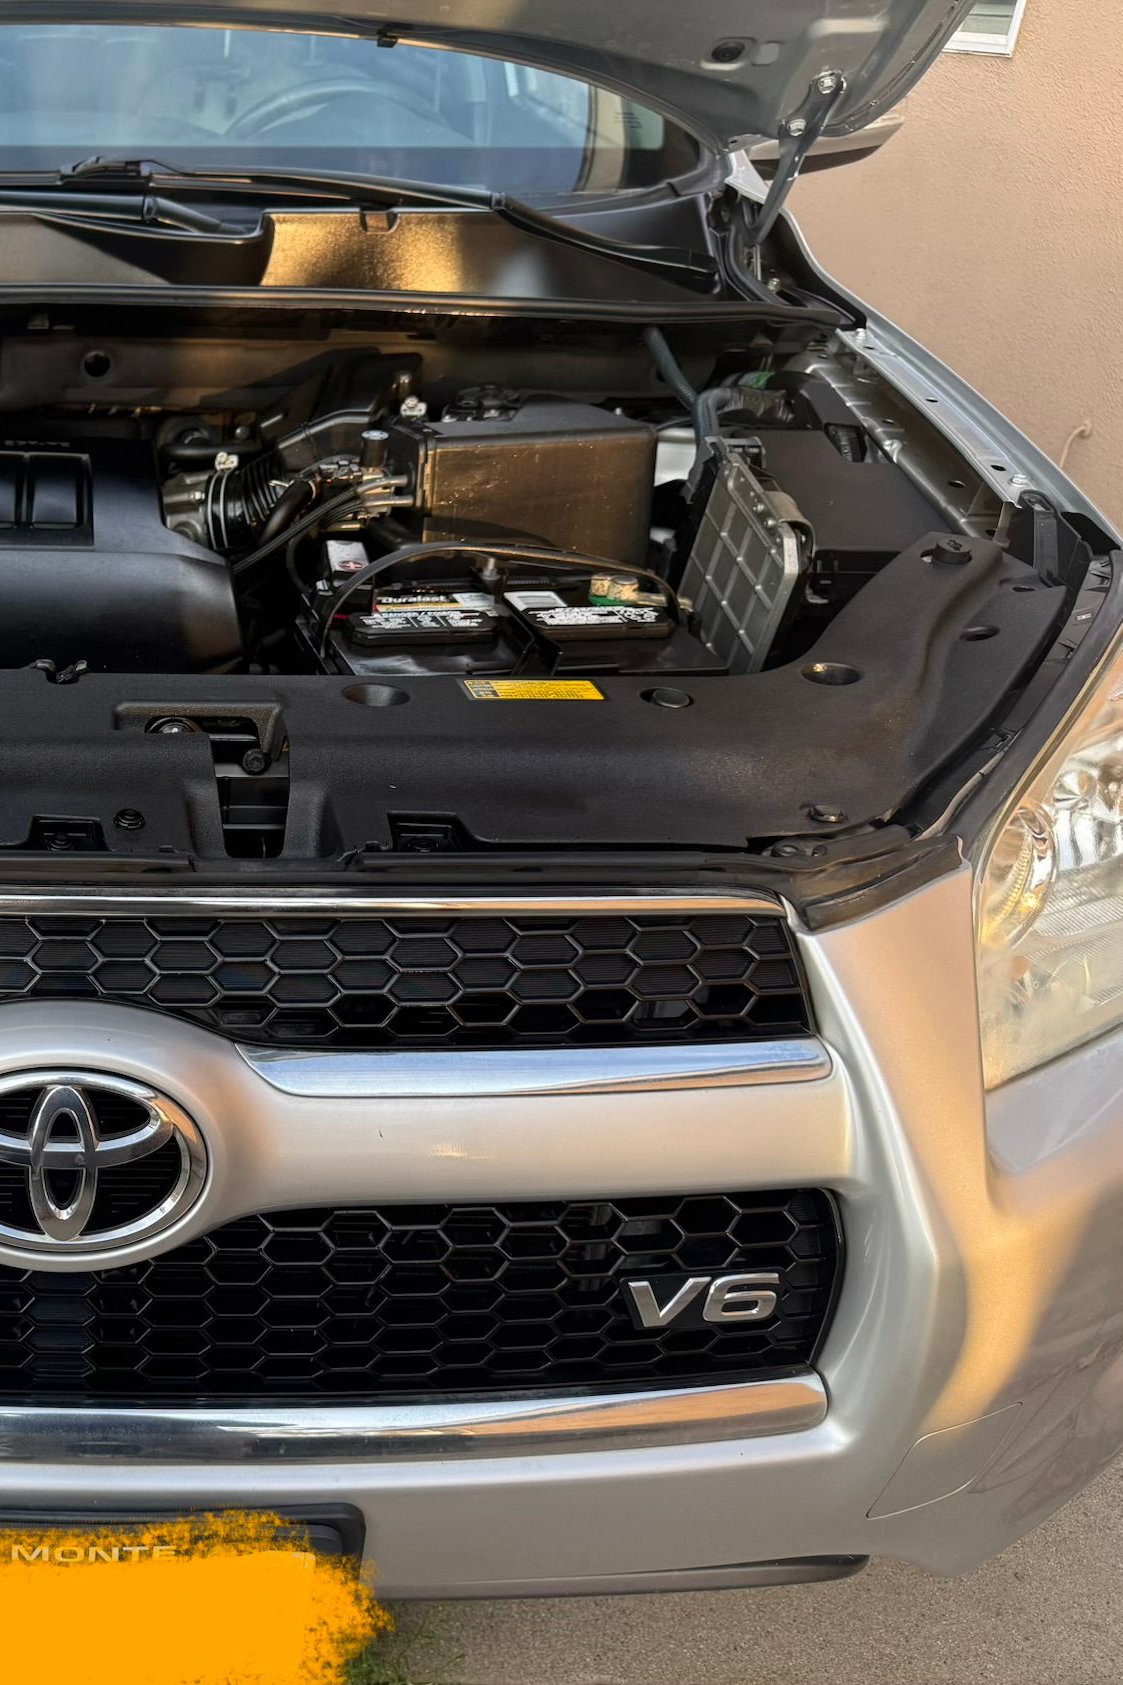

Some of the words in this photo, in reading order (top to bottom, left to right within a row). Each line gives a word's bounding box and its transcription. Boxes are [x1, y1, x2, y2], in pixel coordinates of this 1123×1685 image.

[376, 595, 447, 604] Duralast
[628, 1272, 781, 1328] V6
[11, 1544, 177, 1563] MONTE
